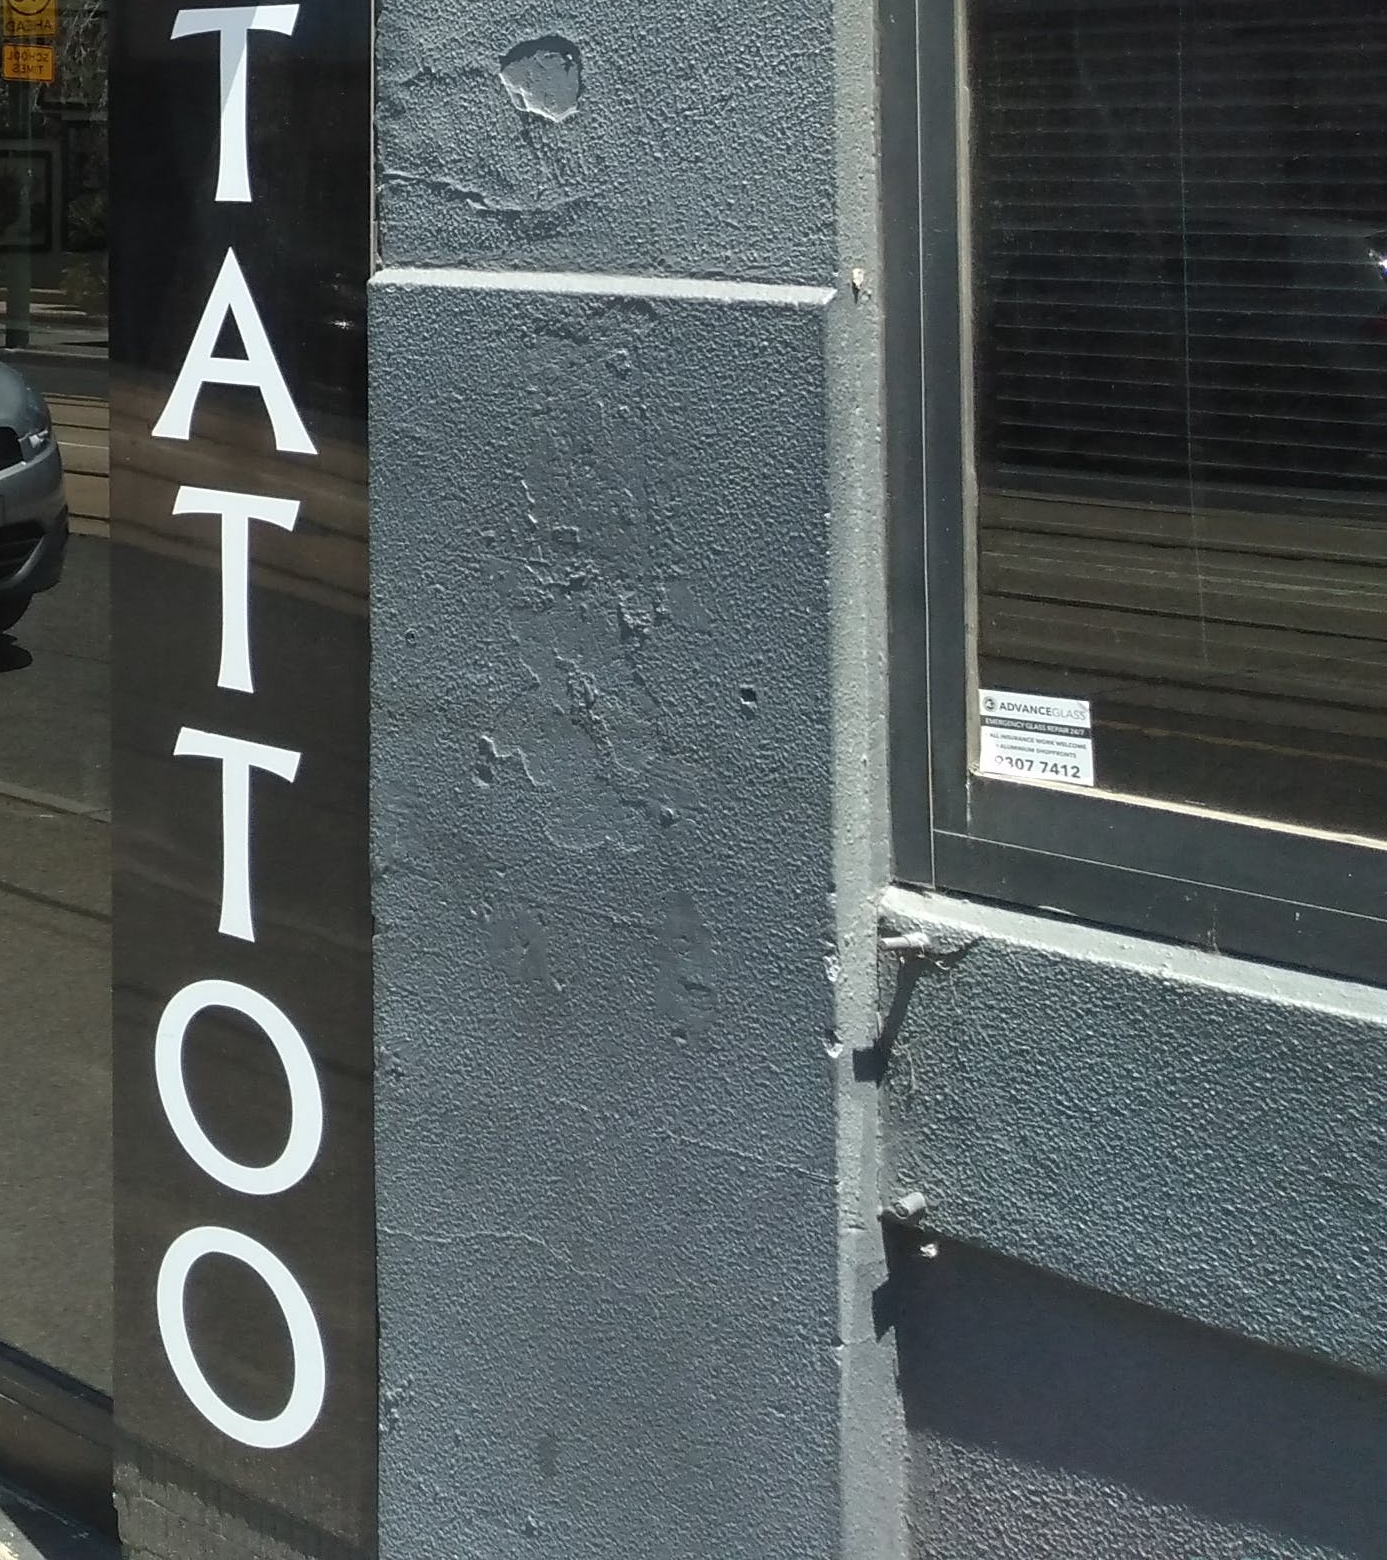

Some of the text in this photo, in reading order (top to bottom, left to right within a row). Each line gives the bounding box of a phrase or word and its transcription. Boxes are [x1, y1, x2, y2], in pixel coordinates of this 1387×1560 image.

[999, 702, 1086, 720] ADVANCEGLASS
[150, 3, 326, 1450] TATTOO
[985, 717, 1025, 728] EMERGENCY
[1025, 721, 1046, 731] GLASS
[1047, 724, 1069, 734] REPAIR
[1001, 734, 1034, 743] INSURANCE
[1035, 738, 1055, 746] WORK
[1056, 740, 1087, 750] WELCOME
[1039, 761, 1081, 779] 7412
